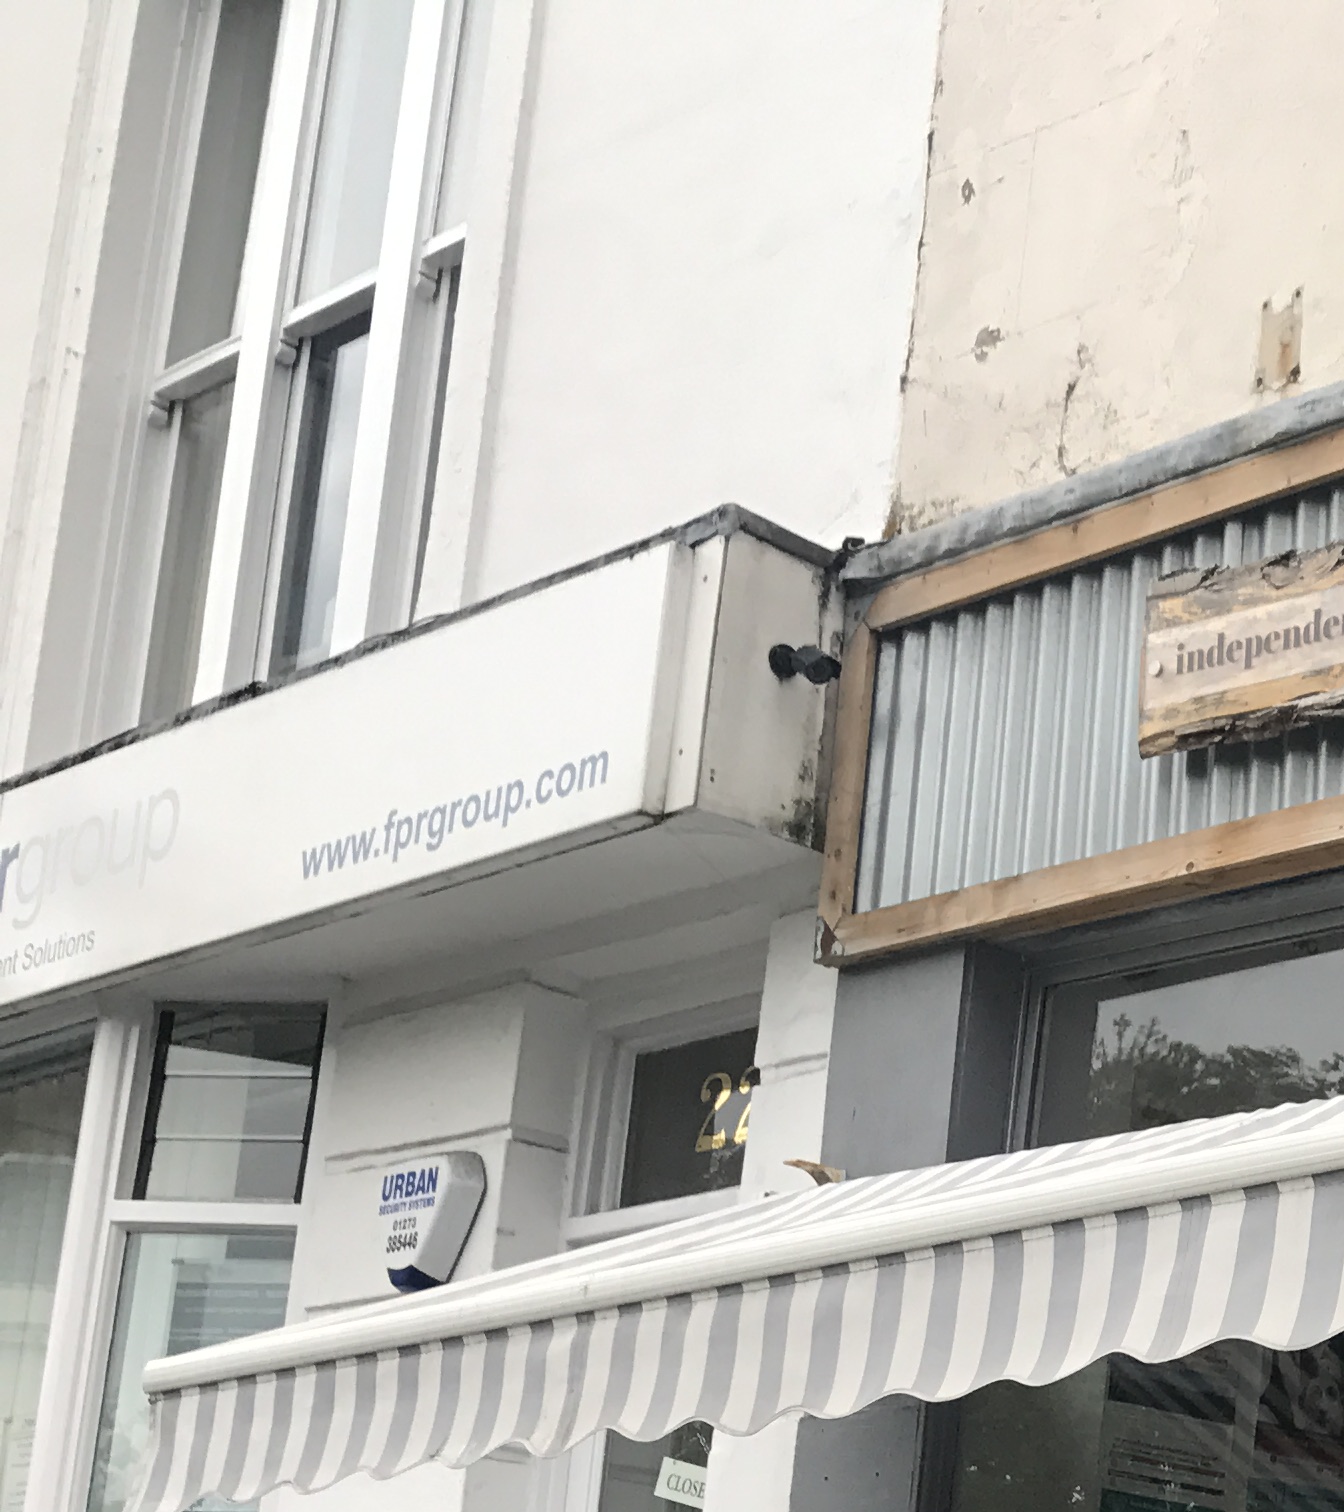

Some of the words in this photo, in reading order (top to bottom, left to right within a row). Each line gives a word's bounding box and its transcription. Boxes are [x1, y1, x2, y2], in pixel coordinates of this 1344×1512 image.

[300, 749, 610, 881] www.fprgroup.com
[21, 929, 96, 971] Solutions
[381, 1165, 440, 1203] URBAN
[392, 1216, 417, 1232] 01273
